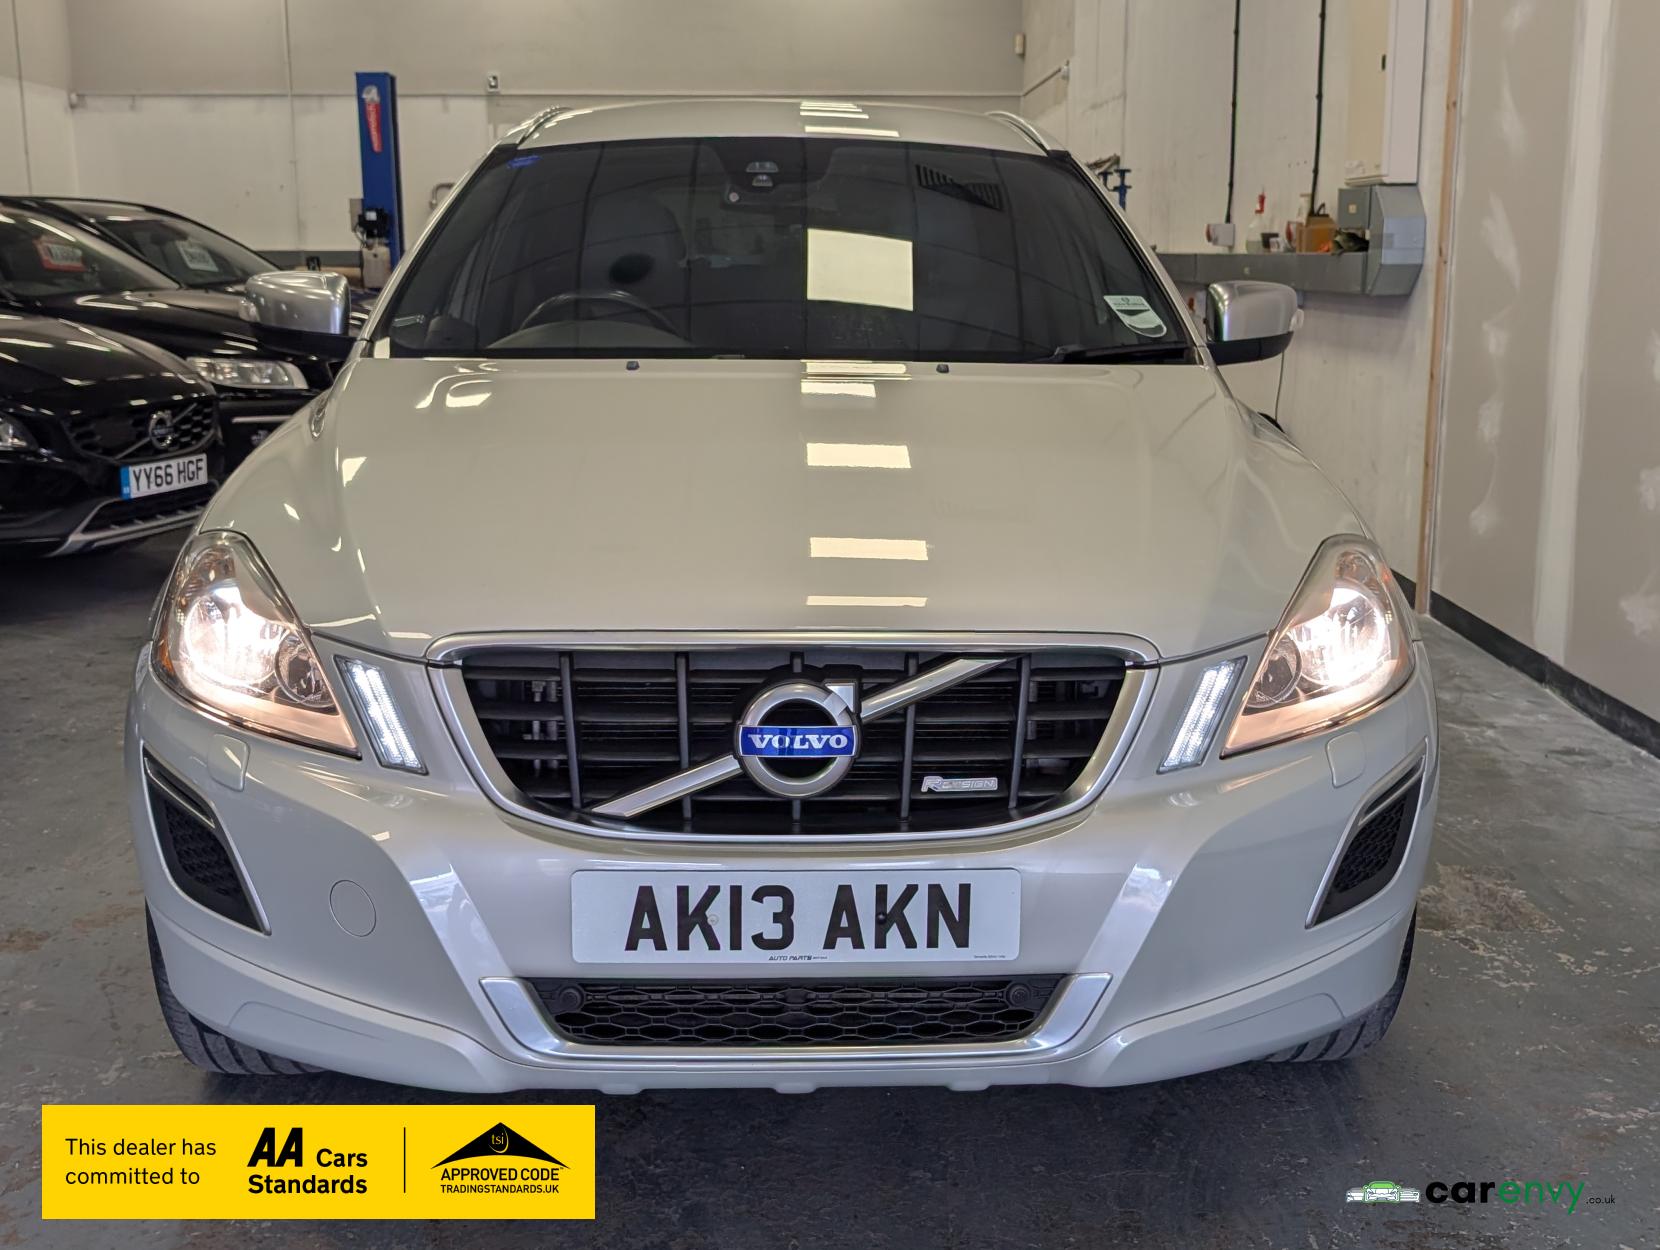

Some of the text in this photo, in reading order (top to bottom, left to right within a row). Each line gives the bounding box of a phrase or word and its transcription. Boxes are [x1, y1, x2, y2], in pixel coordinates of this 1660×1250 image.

[132, 458, 204, 491] YY66 HGF
[747, 734, 848, 749] VOLVO
[624, 883, 972, 952] AK13 AKN
